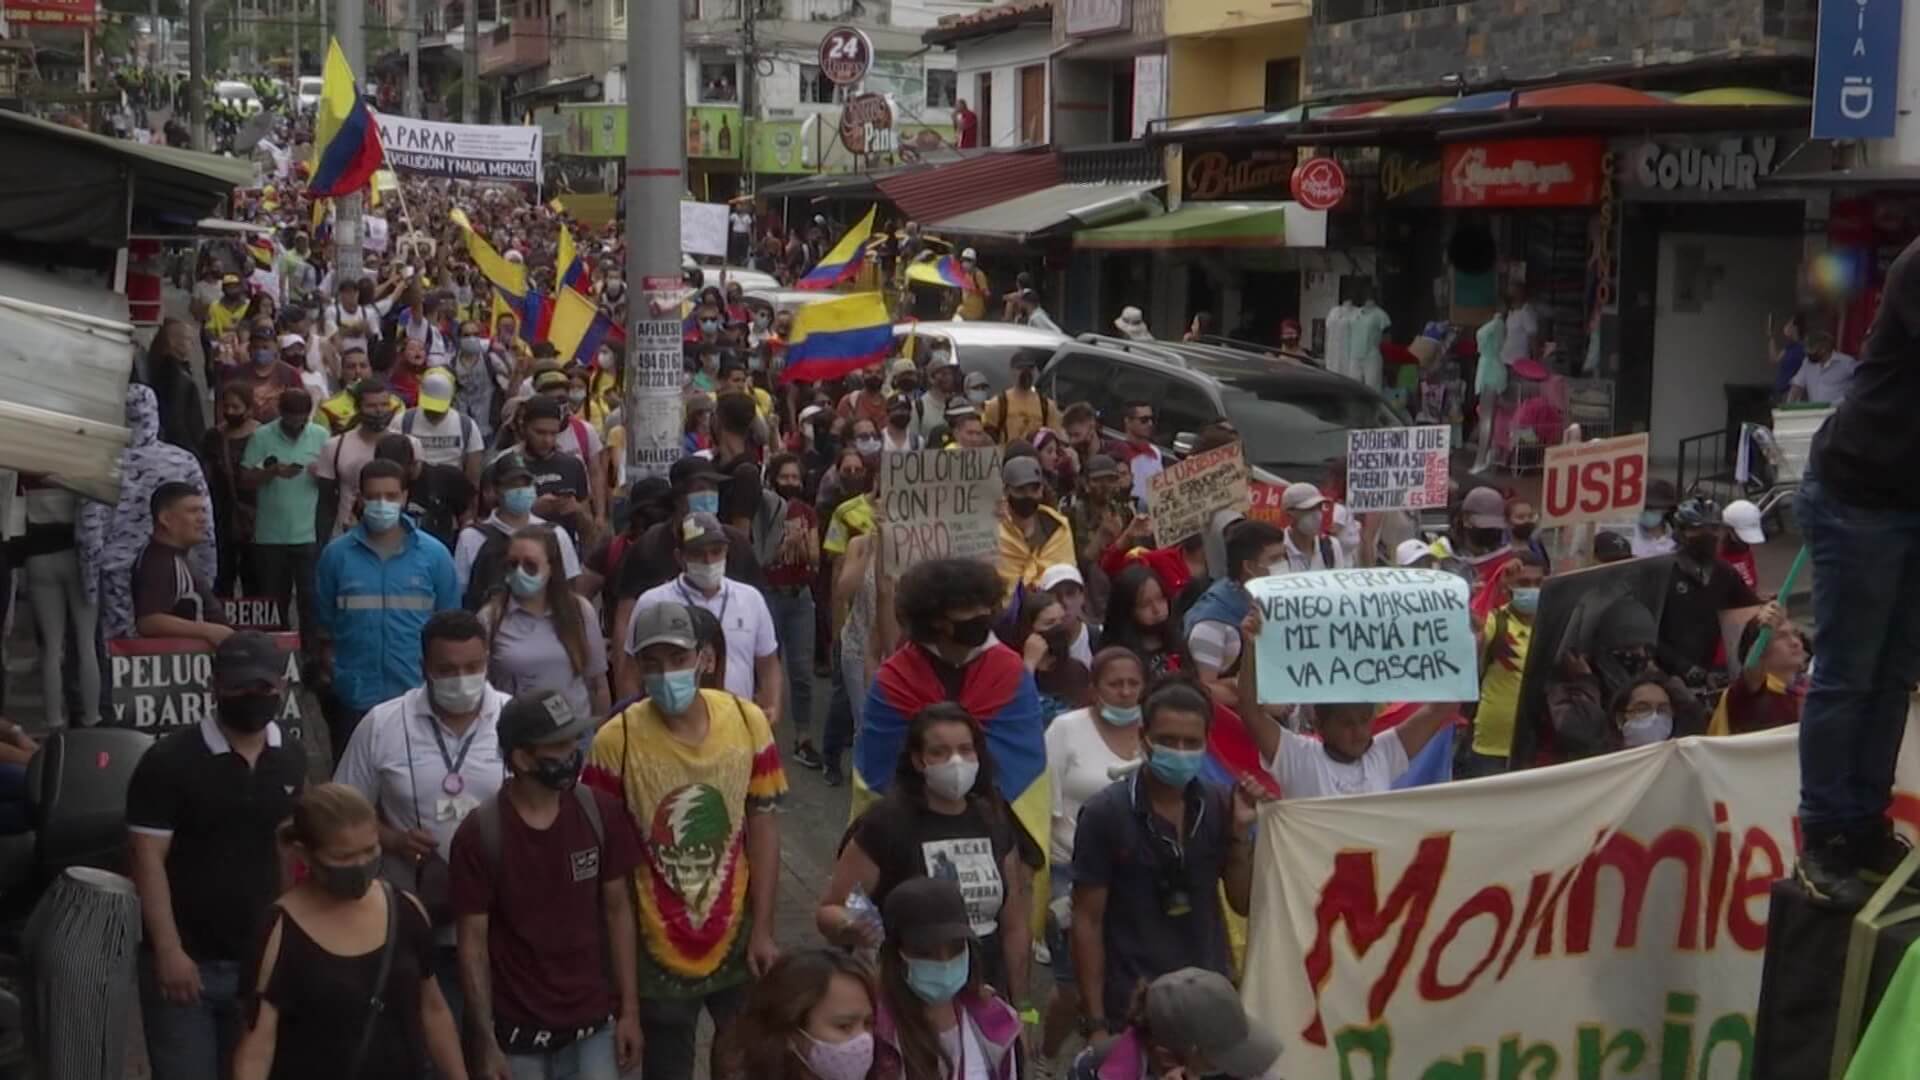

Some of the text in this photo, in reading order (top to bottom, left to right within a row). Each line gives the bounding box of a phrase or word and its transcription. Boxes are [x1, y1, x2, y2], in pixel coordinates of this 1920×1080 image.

[830, 37, 858, 58] 24
[397, 126, 456, 153] PARAR
[388, 150, 445, 171] VOLUCIÓN
[1637, 136, 1776, 192] COUNTRY
[1416, 428, 1445, 449] QUE
[885, 483, 977, 522] CON P DE
[1546, 454, 1644, 518] USB
[893, 521, 951, 566] PARO
[1257, 588, 1466, 622] VENGO A MARCHAR
[1285, 616, 1450, 651] MI MAMÁ ME
[112, 651, 300, 689] PELUQA
[1286, 649, 1462, 687] VA A CASCAR
